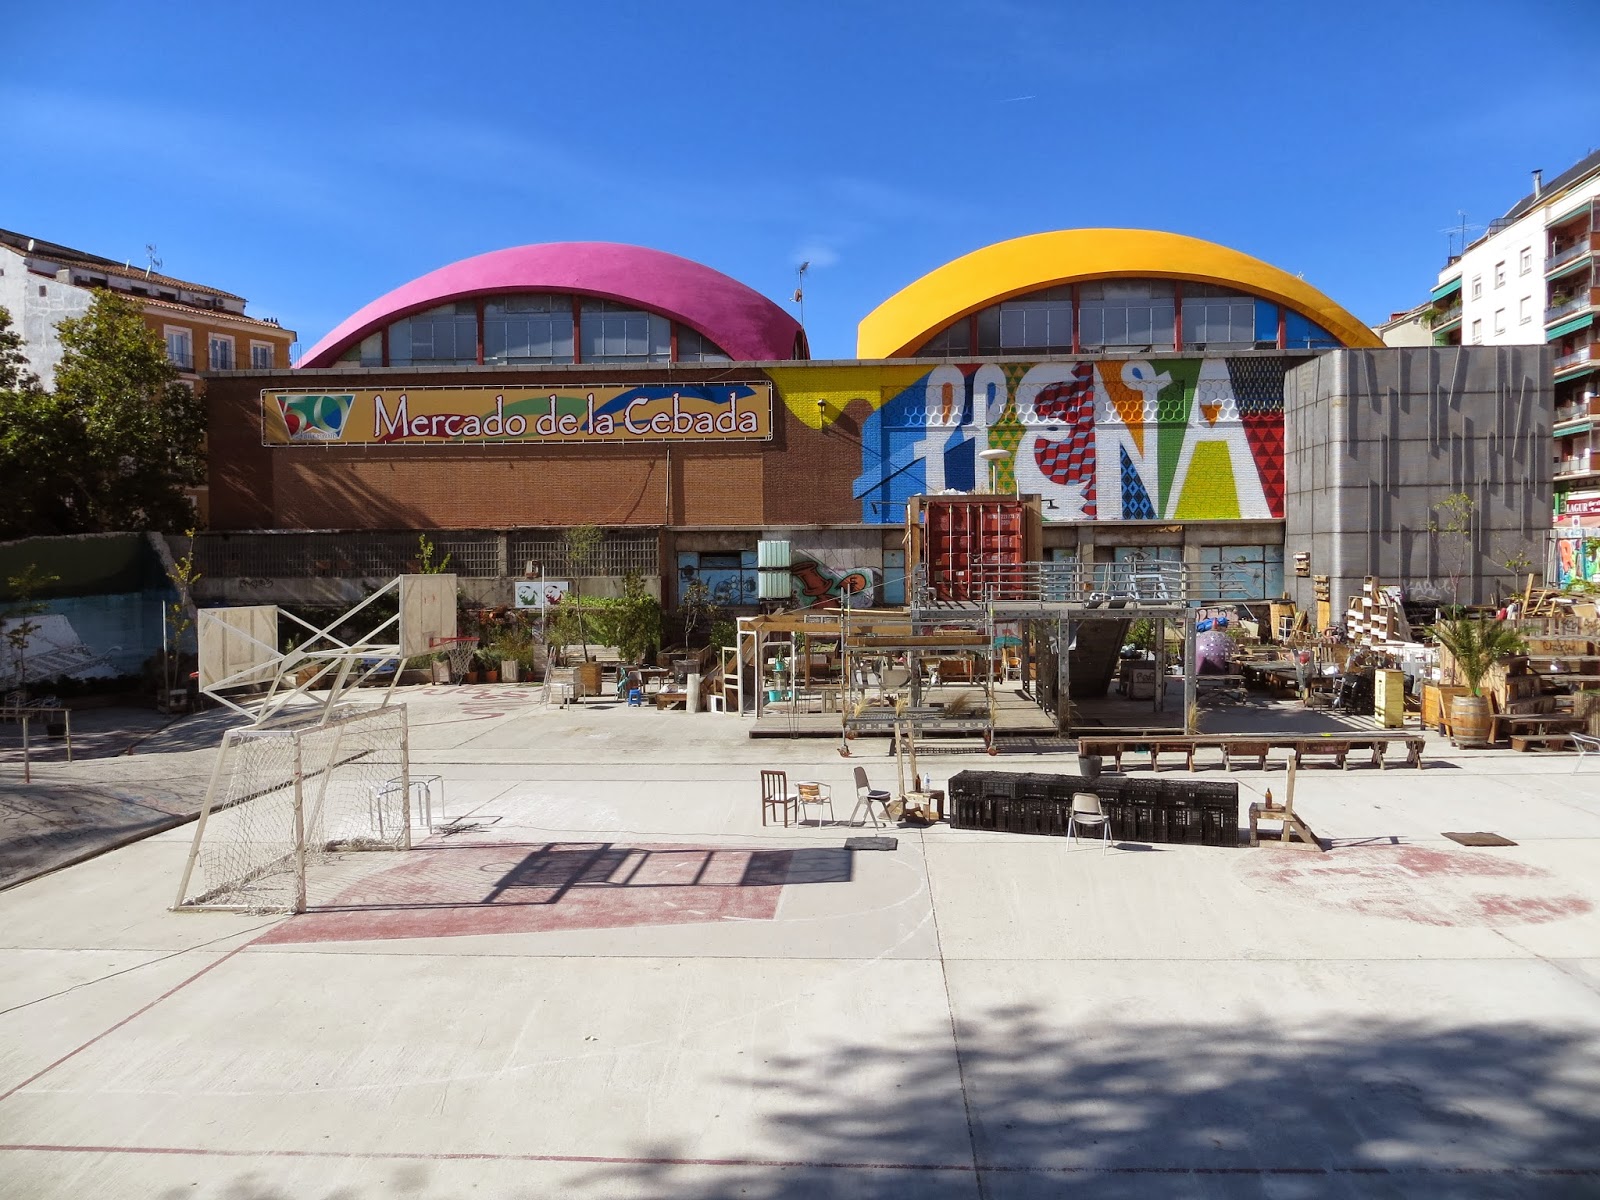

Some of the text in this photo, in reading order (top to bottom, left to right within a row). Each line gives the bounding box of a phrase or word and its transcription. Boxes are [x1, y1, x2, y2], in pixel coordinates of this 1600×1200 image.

[283, 396, 349, 436] 50
[374, 392, 758, 437] Mercado de la Cebada
